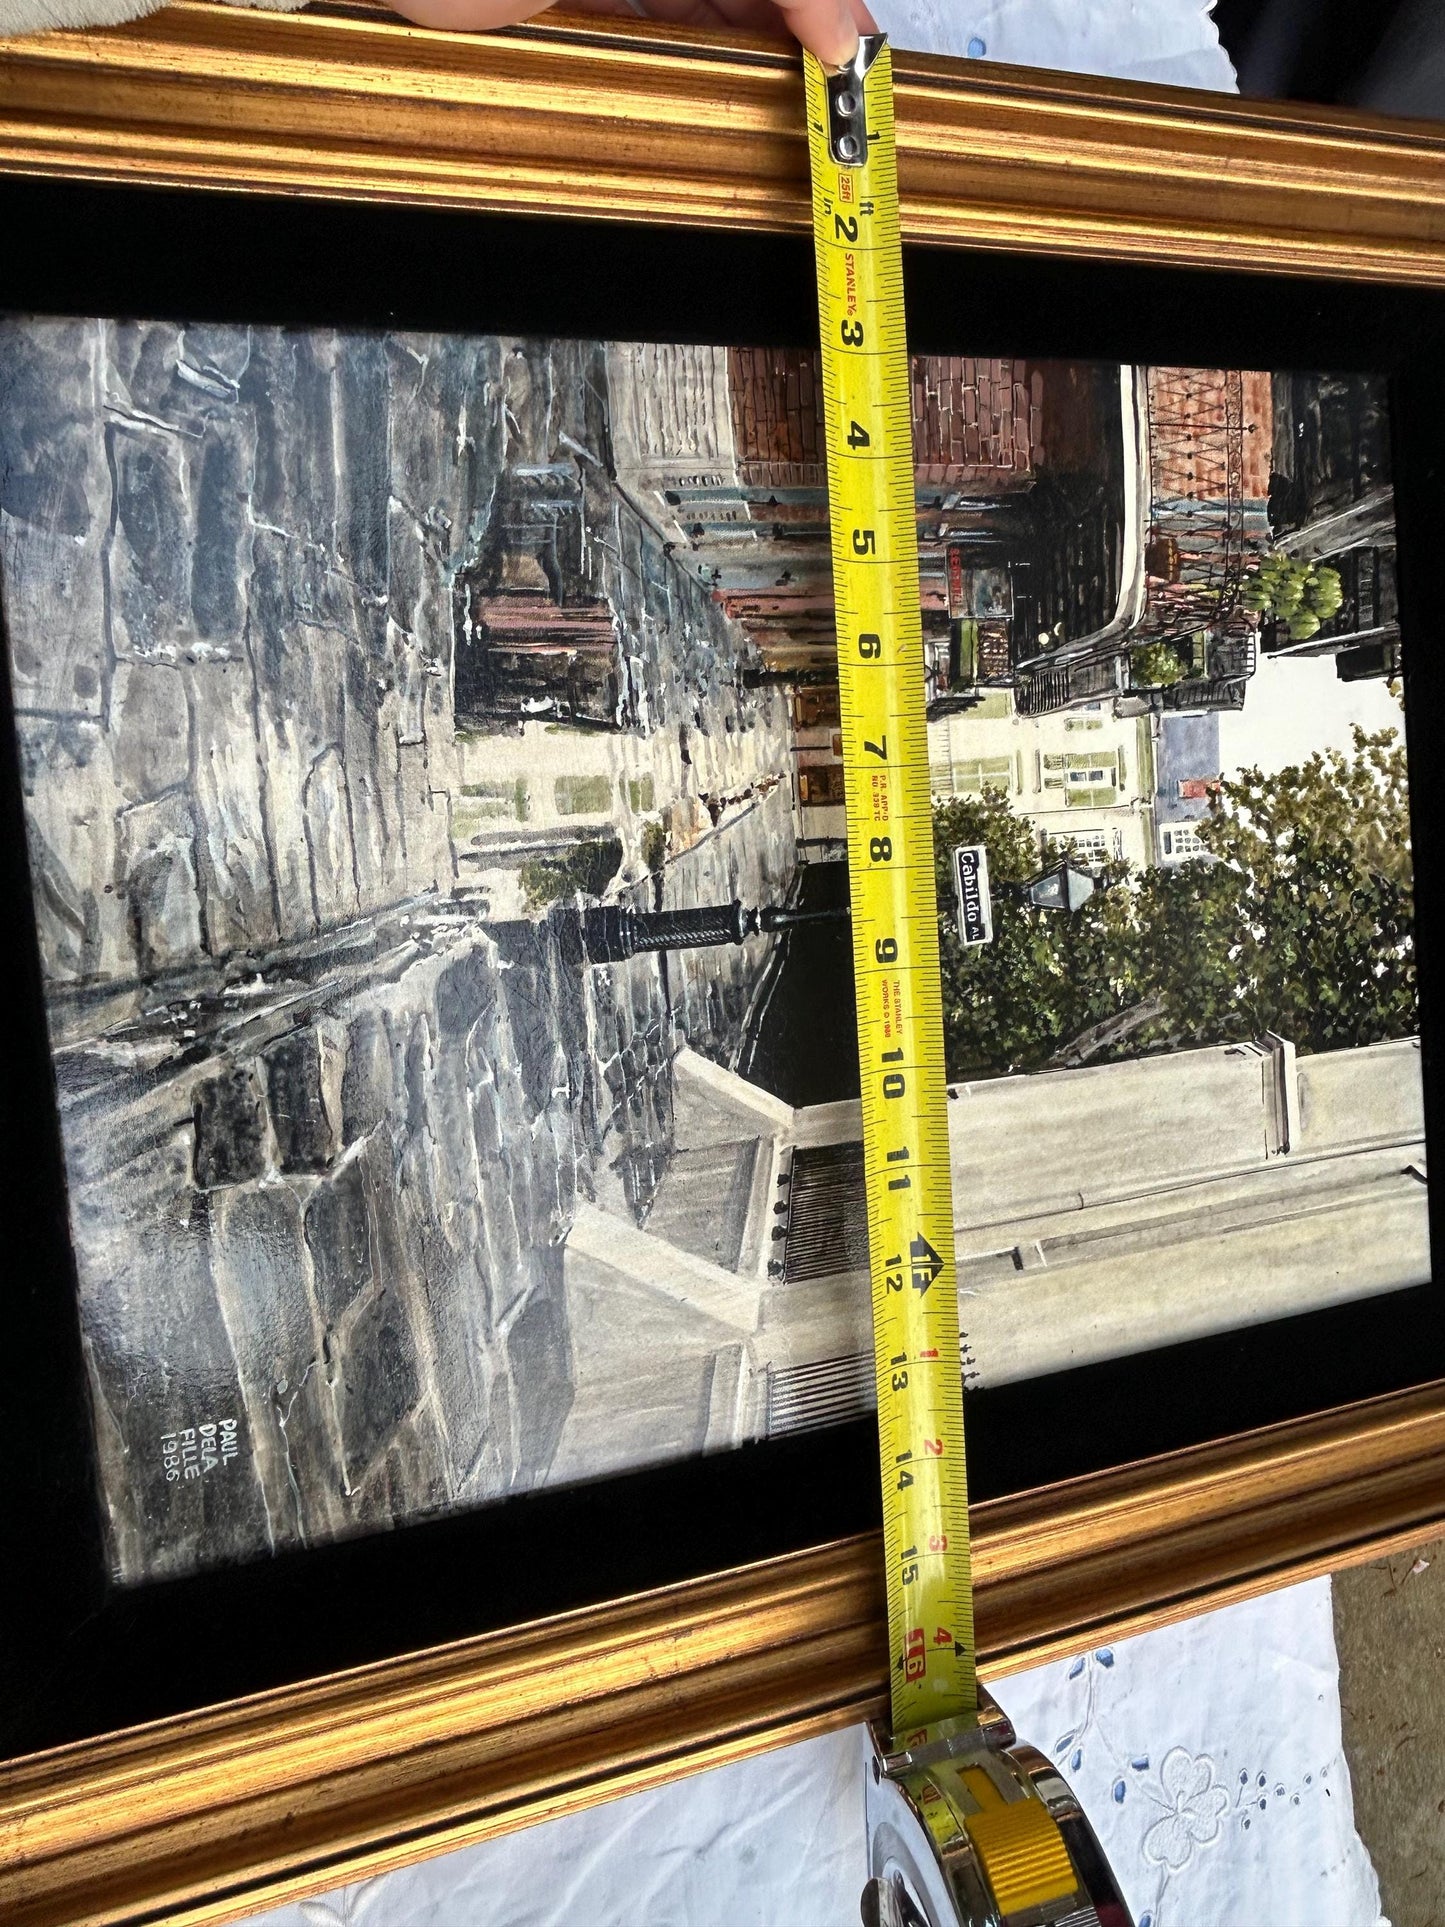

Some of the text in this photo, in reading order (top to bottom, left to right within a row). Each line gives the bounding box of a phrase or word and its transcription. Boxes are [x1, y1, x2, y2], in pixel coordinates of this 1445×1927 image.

[813, 123, 823, 133] 1
[867, 131, 880, 141] 1
[840, 175, 851, 203] 25ft
[859, 201, 874, 217] ft
[834, 213, 858, 243] 2
[840, 319, 864, 348] 3
[847, 420, 871, 450] 4
[852, 529, 876, 556] 5
[858, 633, 882, 659] 6
[864, 735, 887, 761] 7
[869, 836, 893, 863] 8
[960, 851, 980, 940] Cabildo AL
[875, 938, 898, 964] 9
[881, 980, 889, 1010] WORKS
[893, 980, 903, 1035] THE STANLEY
[881, 1047, 906, 1100] 10
[886, 1146, 912, 1191] 11
[885, 1254, 903, 1295] 12
[912, 1254, 932, 1282] 1F
[920, 1348, 939, 1359] 1
[890, 1351, 909, 1392] 13
[160, 1432, 180, 1481] 1986
[179, 1428, 200, 1480] FILLE
[199, 1423, 219, 1473] DELA
[219, 1418, 238, 1466] PAUL
[924, 1439, 944, 1456] 2
[895, 1449, 914, 1491] 14
[928, 1535, 948, 1552] 3
[901, 1545, 918, 1585] 15
[933, 1627, 953, 1645] 4
[907, 1633, 925, 1677] 16
